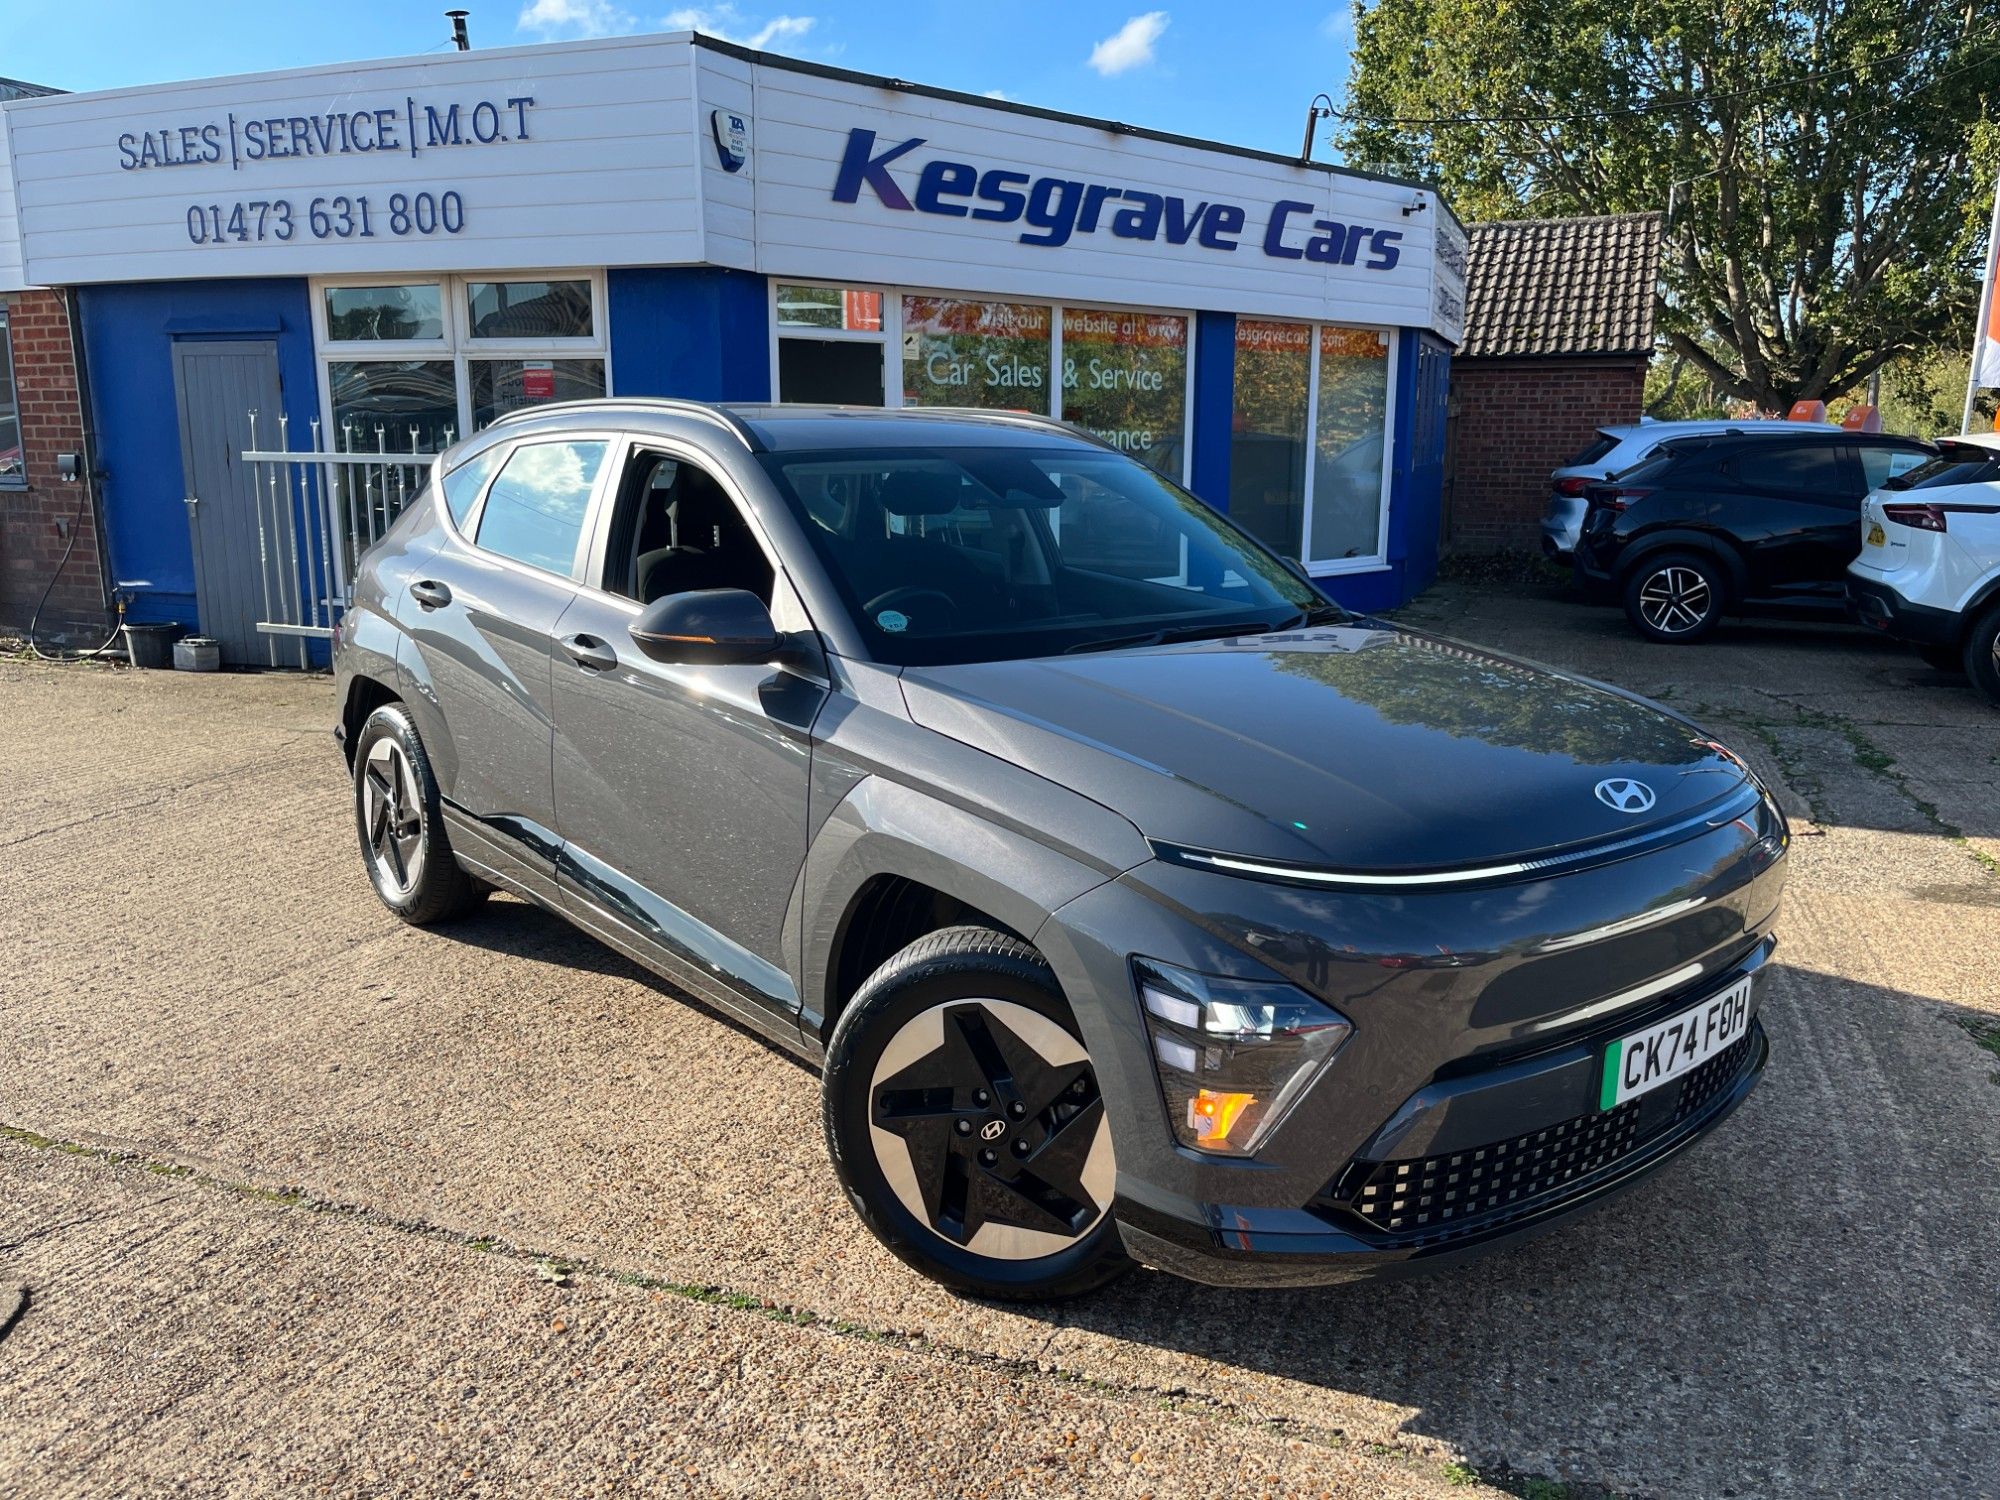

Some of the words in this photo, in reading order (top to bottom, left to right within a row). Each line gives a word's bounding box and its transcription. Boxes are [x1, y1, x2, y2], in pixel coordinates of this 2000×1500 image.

[424, 97, 535, 146] M.O.T
[728, 115, 745, 131] TA
[187, 199, 295, 245] 01473
[309, 196, 375, 239] 631
[389, 190, 465, 236] 800
[832, 127, 1247, 251] Kesgrave
[1263, 199, 1404, 271] Cars
[1017, 315, 1043, 330] our
[1063, 316, 1118, 334] website
[927, 351, 975, 385] Car
[984, 354, 1043, 388] Sales
[1063, 358, 1079, 389] &
[1089, 358, 1163, 391] Service
[1624, 1015, 1699, 1090] CK74
[1703, 986, 1747, 1053] FOH
